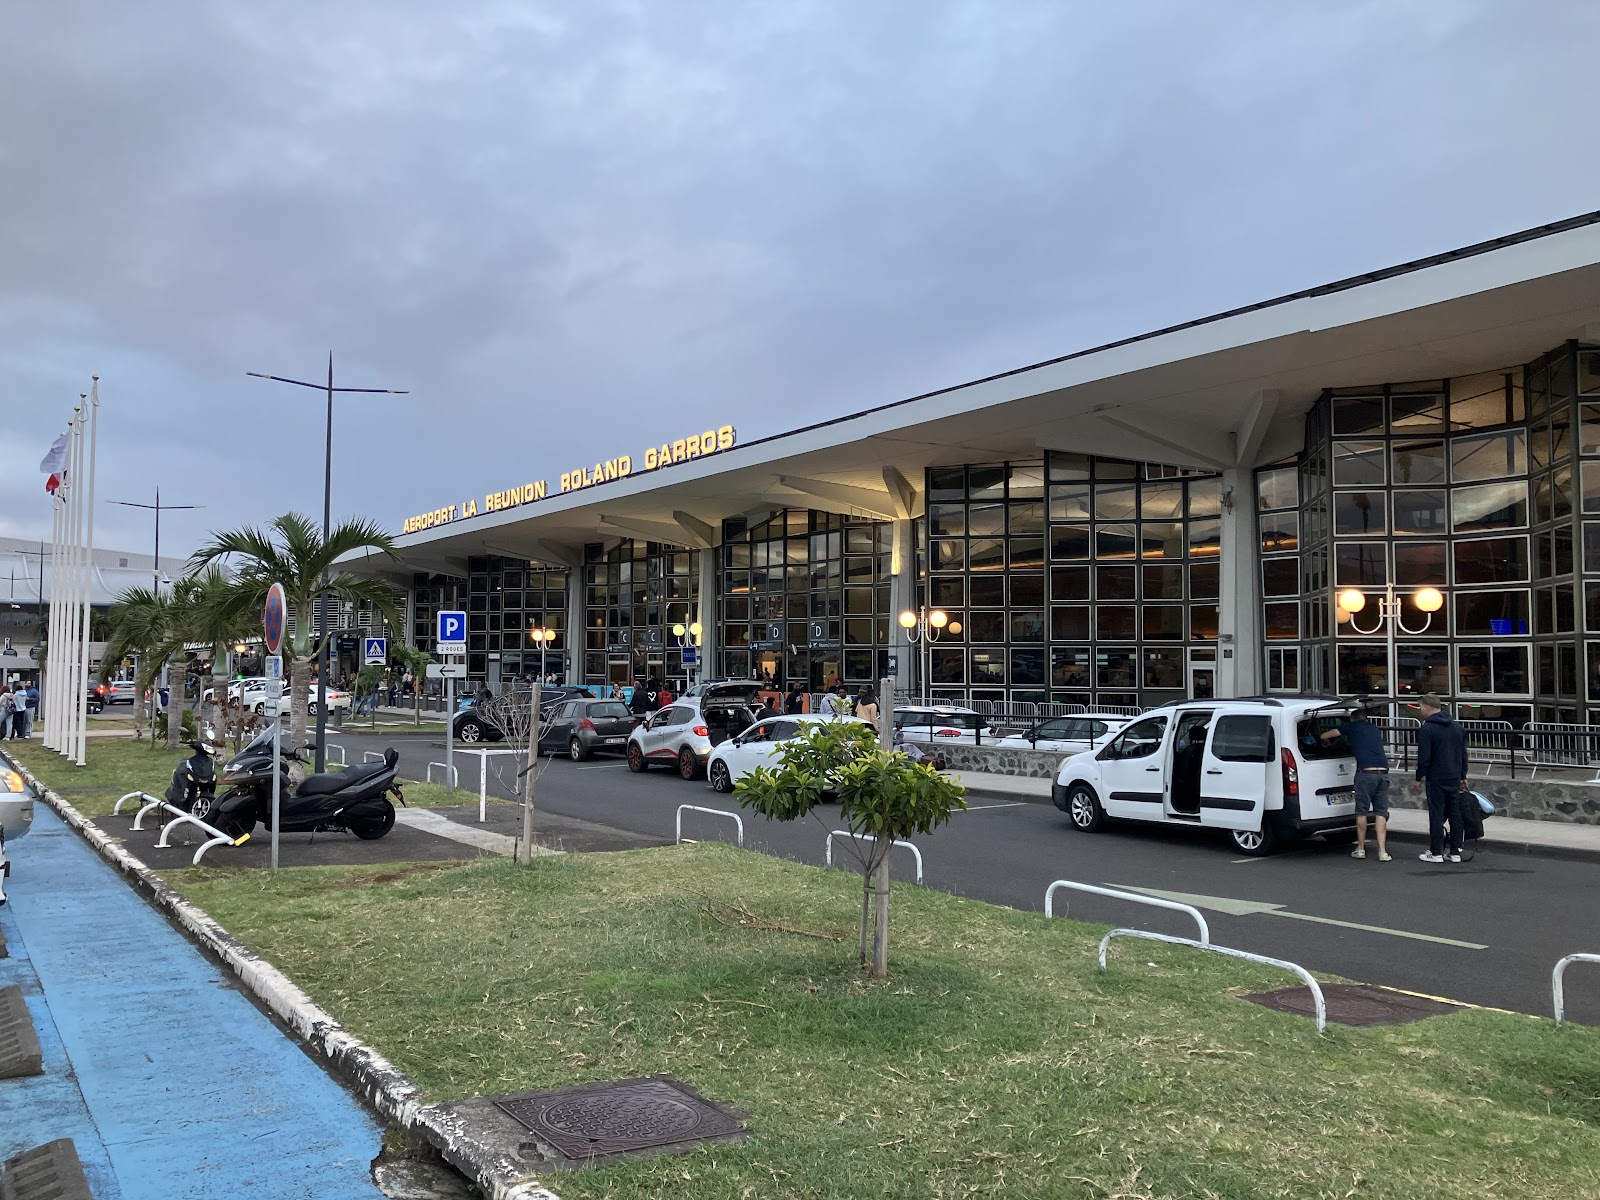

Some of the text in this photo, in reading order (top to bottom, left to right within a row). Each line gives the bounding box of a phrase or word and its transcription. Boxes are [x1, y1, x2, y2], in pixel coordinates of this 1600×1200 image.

[403, 424, 735, 534] AEROPORT LA REUNION ROLAND GARROS
[446, 618, 459, 637] P
[773, 627, 779, 638] D
[815, 626, 822, 637] D
